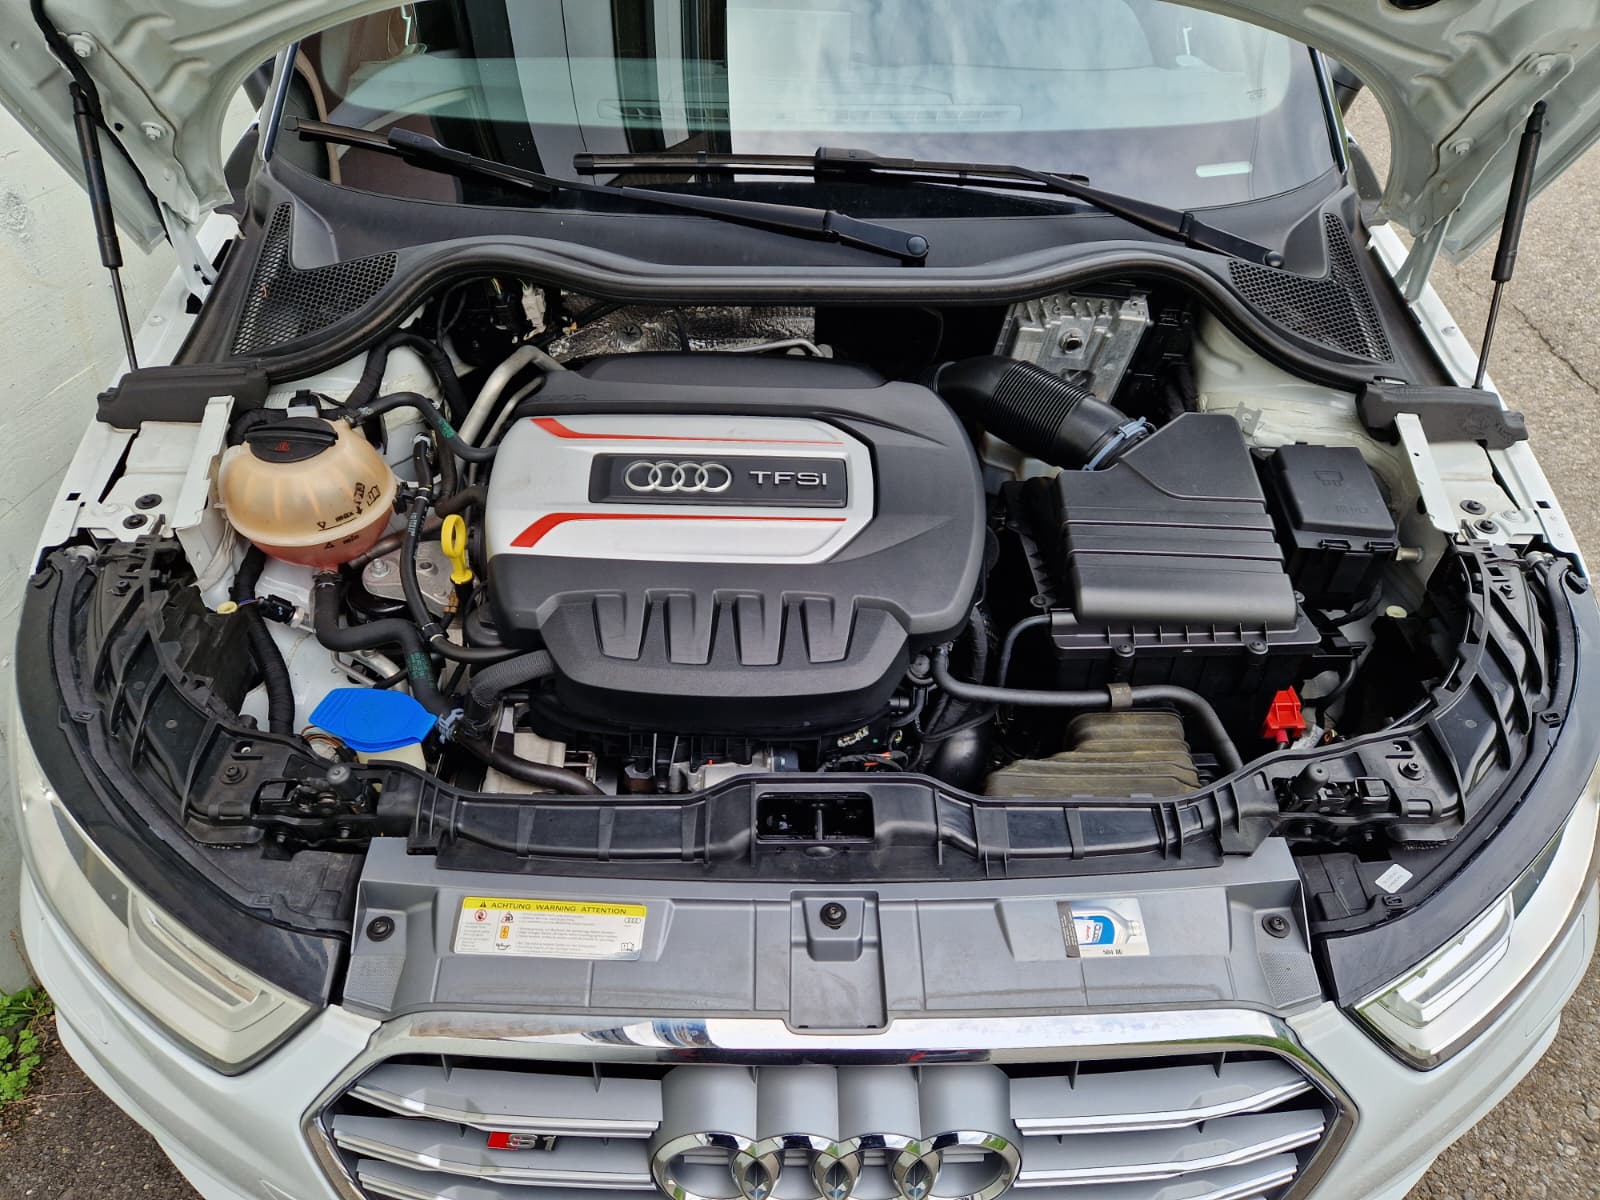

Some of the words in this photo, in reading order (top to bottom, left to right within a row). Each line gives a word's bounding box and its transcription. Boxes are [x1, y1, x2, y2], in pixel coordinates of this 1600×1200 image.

[749, 470, 828, 487] TFSI
[335, 511, 355, 522] max
[491, 902, 531, 911] ACHTUNG
[535, 904, 577, 913] WARNING
[581, 906, 627, 915] ATTENTION
[506, 1134, 557, 1152] S1
